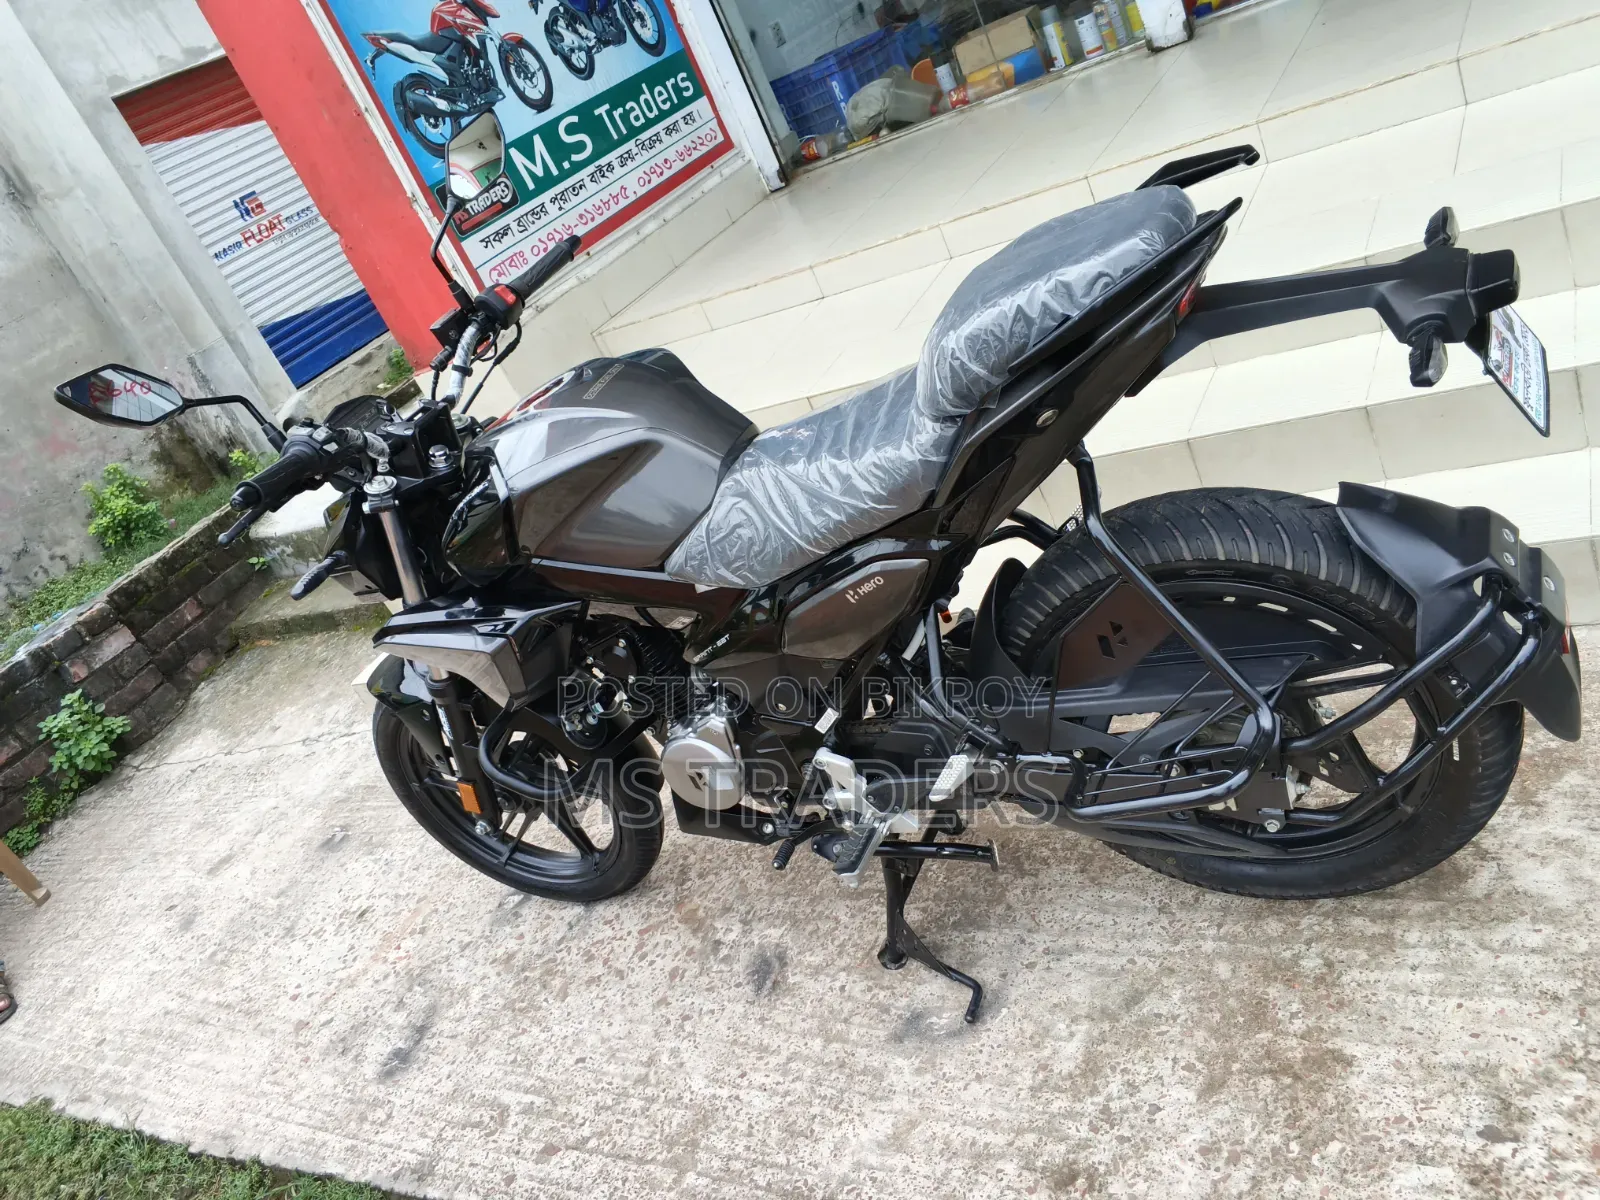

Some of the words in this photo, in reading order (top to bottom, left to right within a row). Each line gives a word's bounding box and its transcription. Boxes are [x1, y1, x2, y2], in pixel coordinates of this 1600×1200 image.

[508, 115, 593, 190] M.S
[594, 72, 694, 140] Traders
[465, 181, 510, 216] TRADERS
[479, 223, 515, 249] সকল
[550, 178, 589, 211] পুরাতন
[587, 161, 616, 186] বাইক
[662, 122, 683, 138] করা
[214, 240, 243, 261] NASIR
[240, 213, 286, 248] FLOAT
[284, 206, 314, 225] GLASS
[857, 576, 884, 596] Hero
